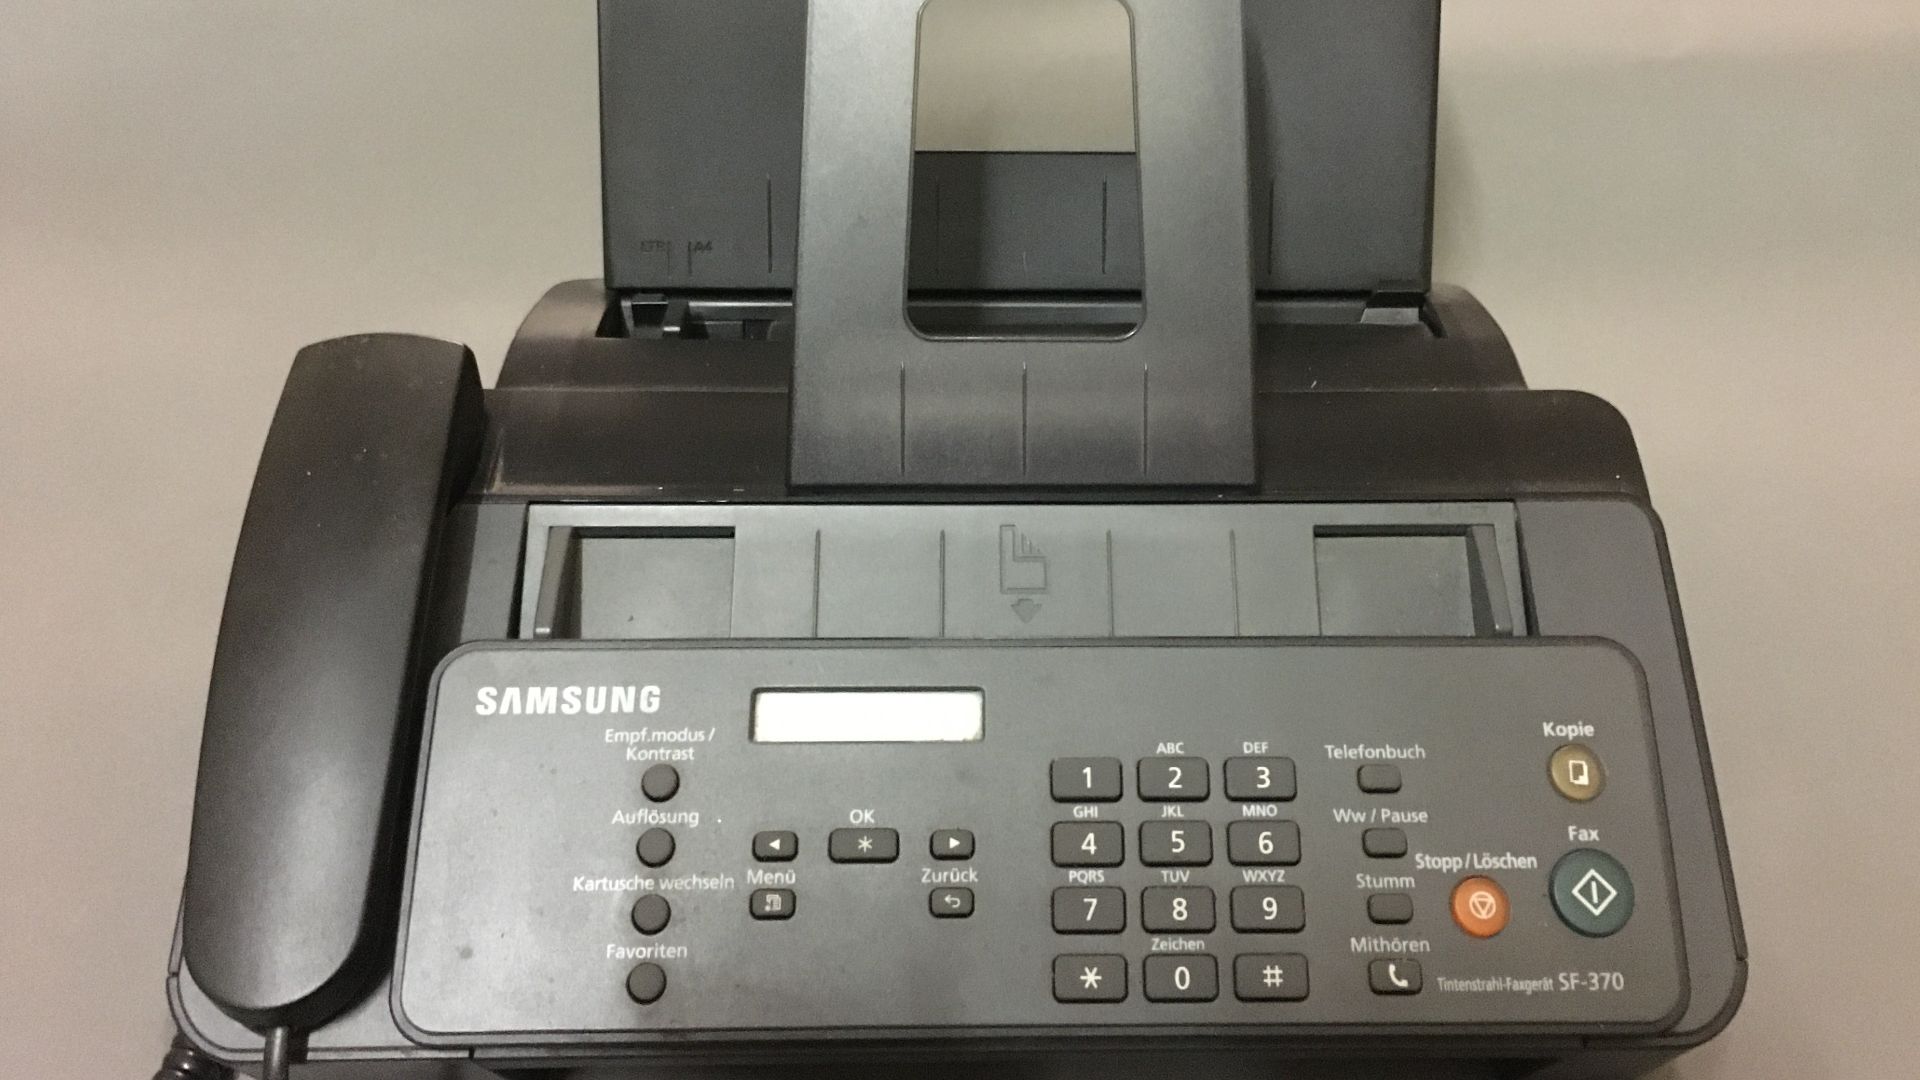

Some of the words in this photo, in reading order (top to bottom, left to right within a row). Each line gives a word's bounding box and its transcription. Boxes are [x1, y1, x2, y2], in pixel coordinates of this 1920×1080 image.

[475, 685, 661, 716] SAMSUNG
[1542, 720, 1595, 741] Kopie
[625, 746, 695, 761] Kontrast
[1155, 741, 1185, 755] ABC
[1242, 741, 1269, 754] DEF
[1323, 743, 1426, 760] Telefonbuch
[1082, 766, 1092, 789] 1
[1168, 766, 1183, 789] 2
[1256, 766, 1271, 789] 3
[611, 808, 700, 828] Auflösung
[849, 808, 875, 825] OK
[1072, 805, 1099, 819] GHI
[1161, 804, 1185, 818] JKL
[1242, 803, 1278, 818] MNO
[1332, 808, 1367, 823] Ww
[1380, 807, 1429, 823] Pause
[1171, 830, 1186, 853] 5
[1567, 825, 1600, 842] Fax
[1081, 832, 1097, 855] 4
[1258, 831, 1274, 855] 6
[572, 874, 655, 892] Kartusche
[659, 872, 735, 891] wechseln
[746, 868, 796, 885] Menü
[921, 866, 979, 884] Zurück
[1068, 869, 1105, 885] PQRS
[1160, 869, 1191, 883] TUV
[1242, 869, 1286, 883] WXYZ
[1355, 872, 1416, 889] Stumm
[1083, 897, 1098, 921] 7
[1172, 897, 1188, 921] 8
[1262, 896, 1278, 921] 9
[605, 941, 688, 960] Favoriten
[1151, 936, 1205, 951] Zeichen
[1350, 936, 1431, 953] Mithören
[1174, 966, 1191, 990] 0
[1262, 964, 1284, 987] #
[1436, 976, 1554, 995] Tintenstrahl-Faxgerät
[1558, 971, 1625, 991] SF-370
